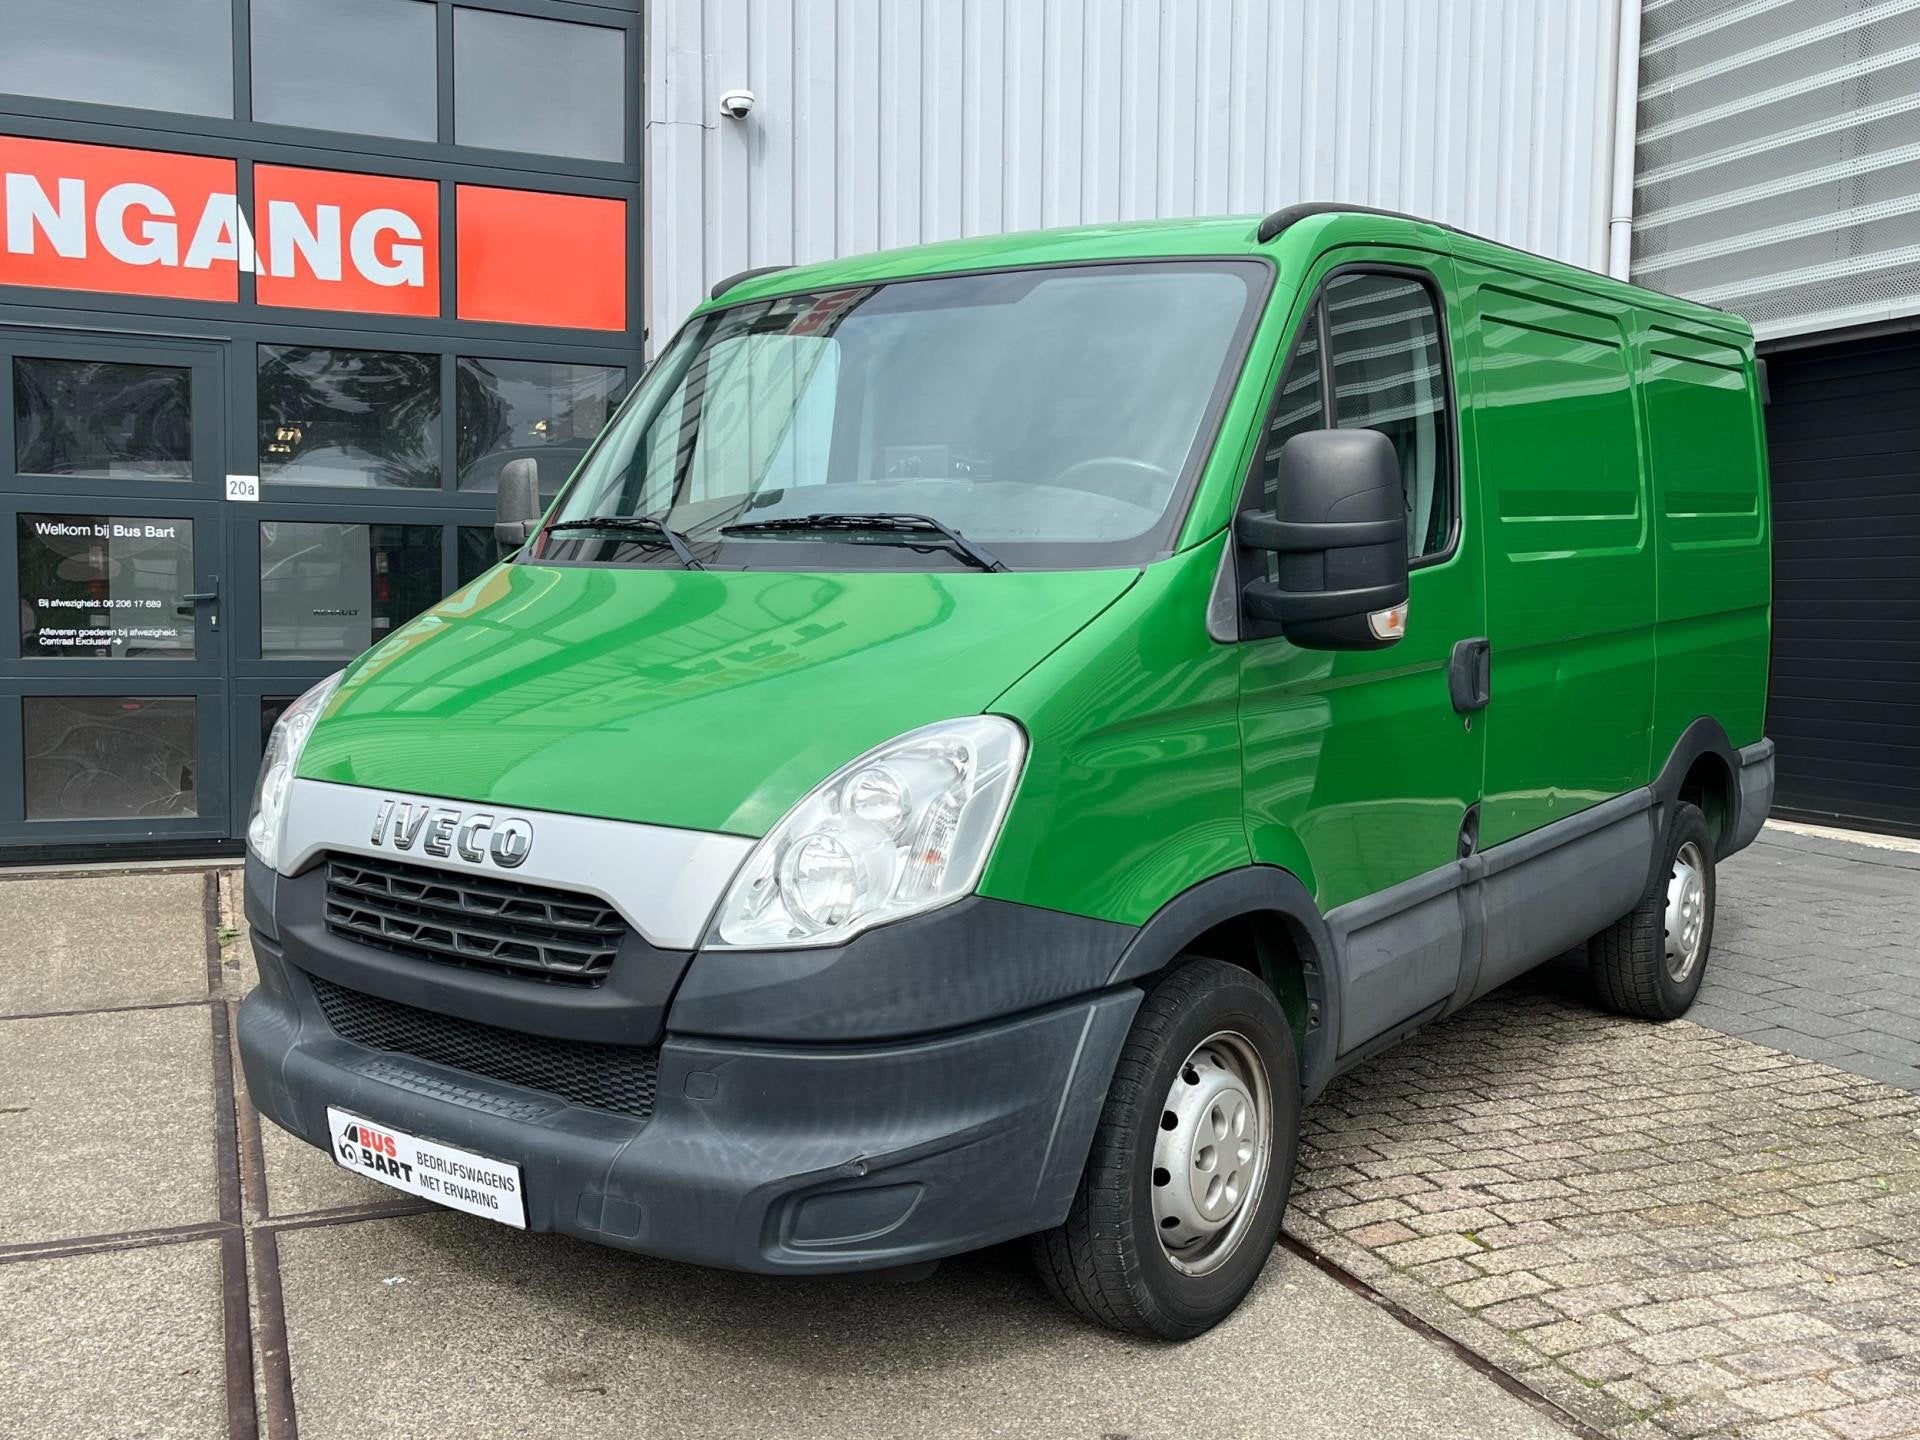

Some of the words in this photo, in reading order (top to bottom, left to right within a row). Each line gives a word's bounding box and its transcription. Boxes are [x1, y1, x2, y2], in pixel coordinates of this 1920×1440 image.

[5, 172, 425, 288] NGANG
[229, 480, 255, 496] 20a
[35, 522, 91, 537] Welkom
[94, 523, 110, 539] bij
[113, 526, 141, 538] Bus
[144, 526, 175, 538] Bart
[38, 598, 49, 609] Bij
[50, 599, 101, 609] afwezigheid:
[133, 599, 144, 608] 17
[39, 637, 74, 646] Centraal
[75, 637, 112, 646] Exclusief
[78, 628, 117, 638] goederen
[118, 628, 128, 638] bij
[370, 799, 534, 869] IVECO
[358, 1126, 397, 1158] BUS
[360, 1148, 413, 1183] BART
[416, 1151, 515, 1192] BEDRIJFSWAGENS
[419, 1173, 441, 1193] MET
[444, 1181, 499, 1210] ERVARING
